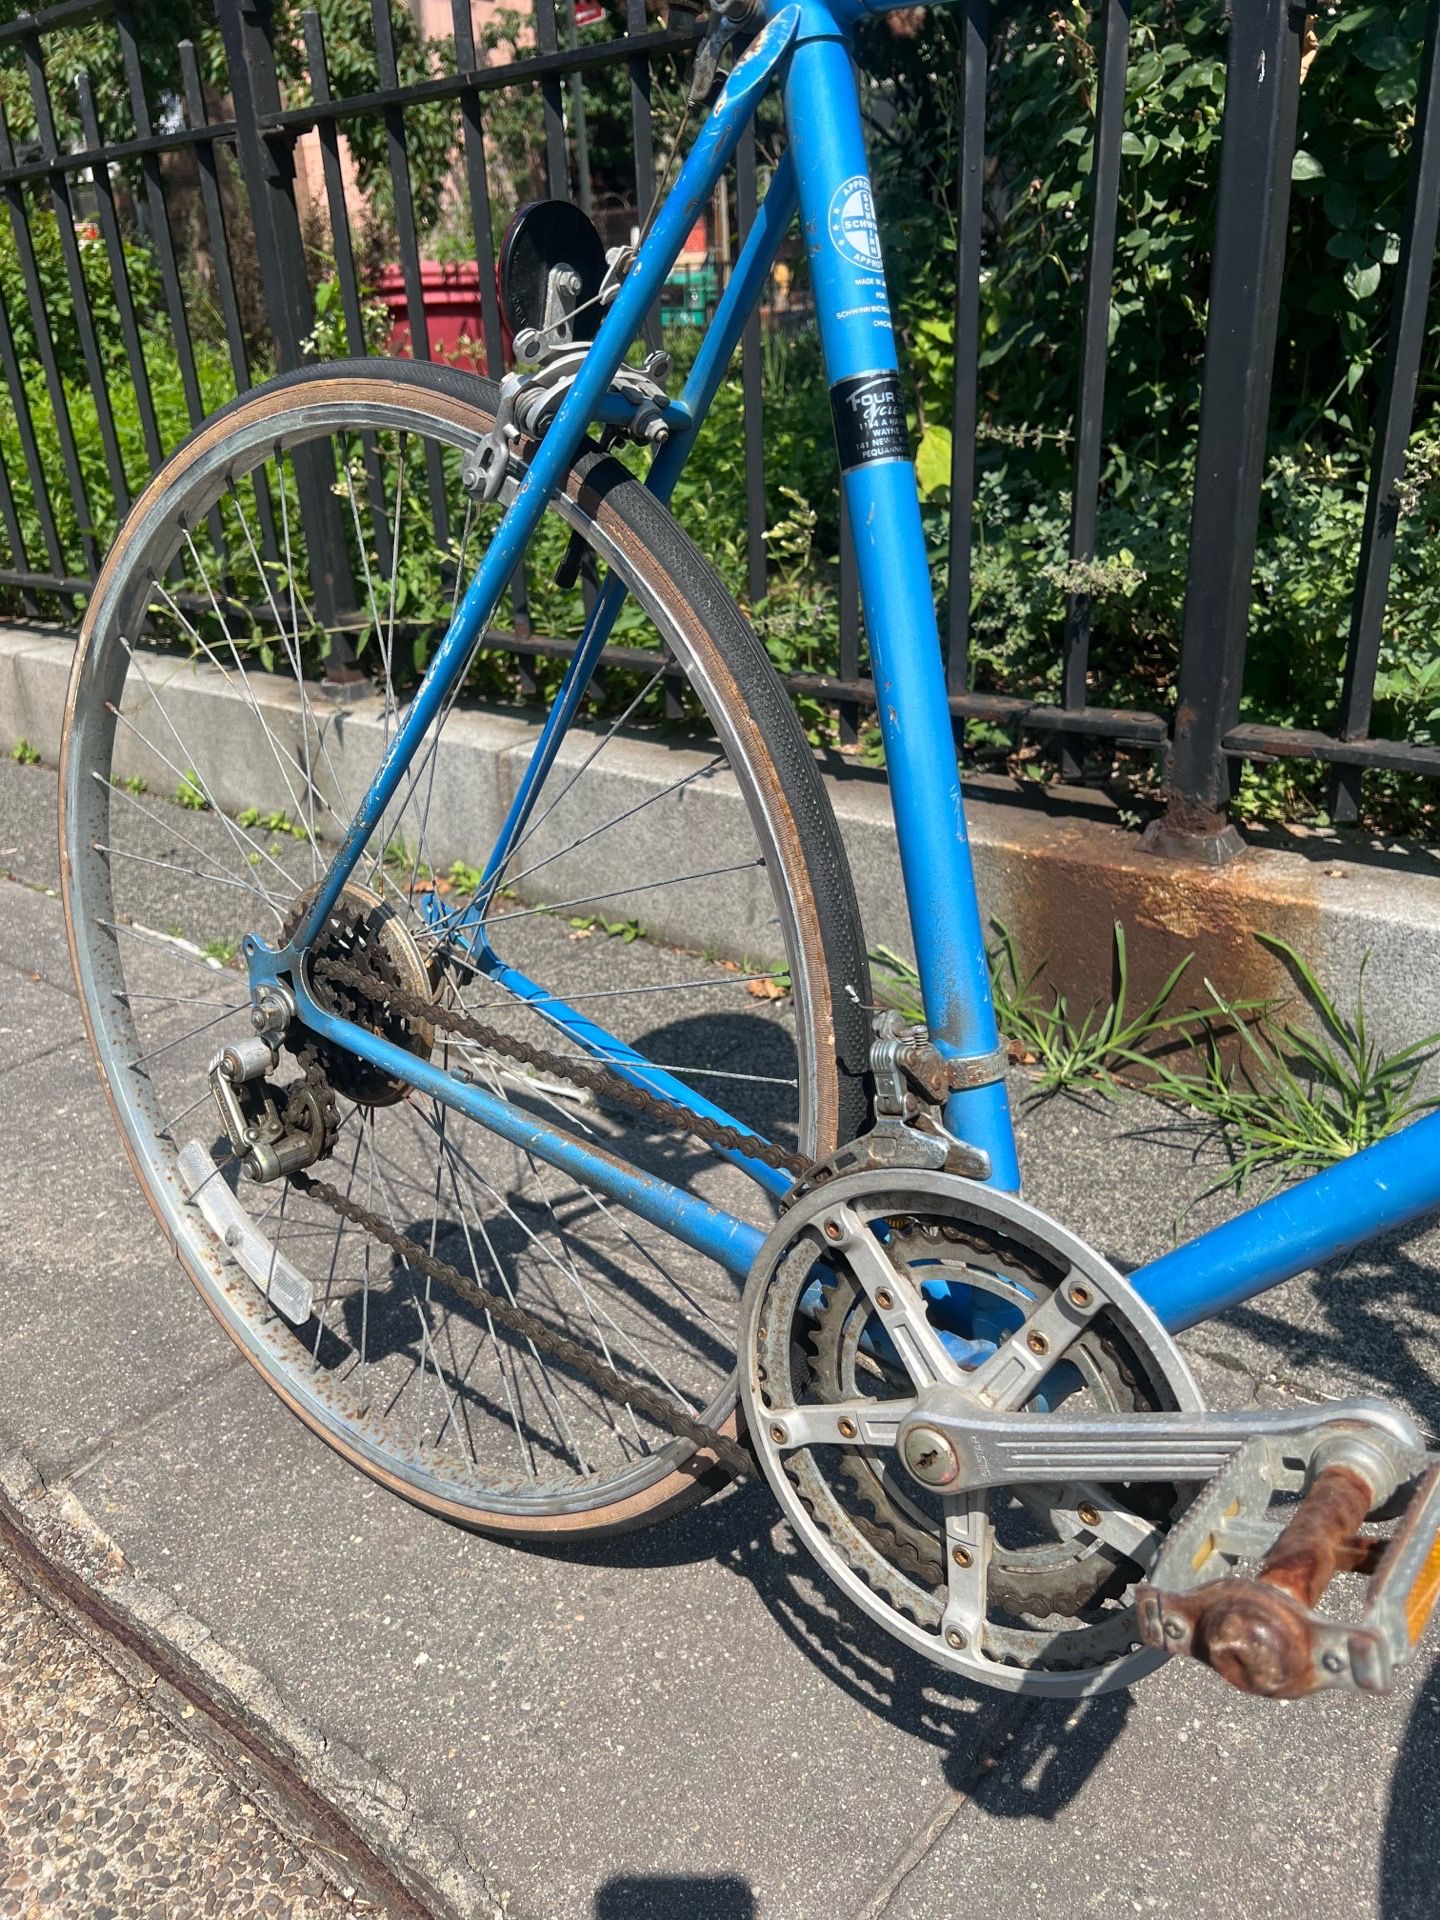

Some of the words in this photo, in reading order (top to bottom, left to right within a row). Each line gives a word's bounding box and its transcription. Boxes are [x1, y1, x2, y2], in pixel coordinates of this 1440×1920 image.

[854, 278, 875, 286] MADE
[836, 306, 871, 320] SCHWINN
[845, 377, 895, 412] FOUR
